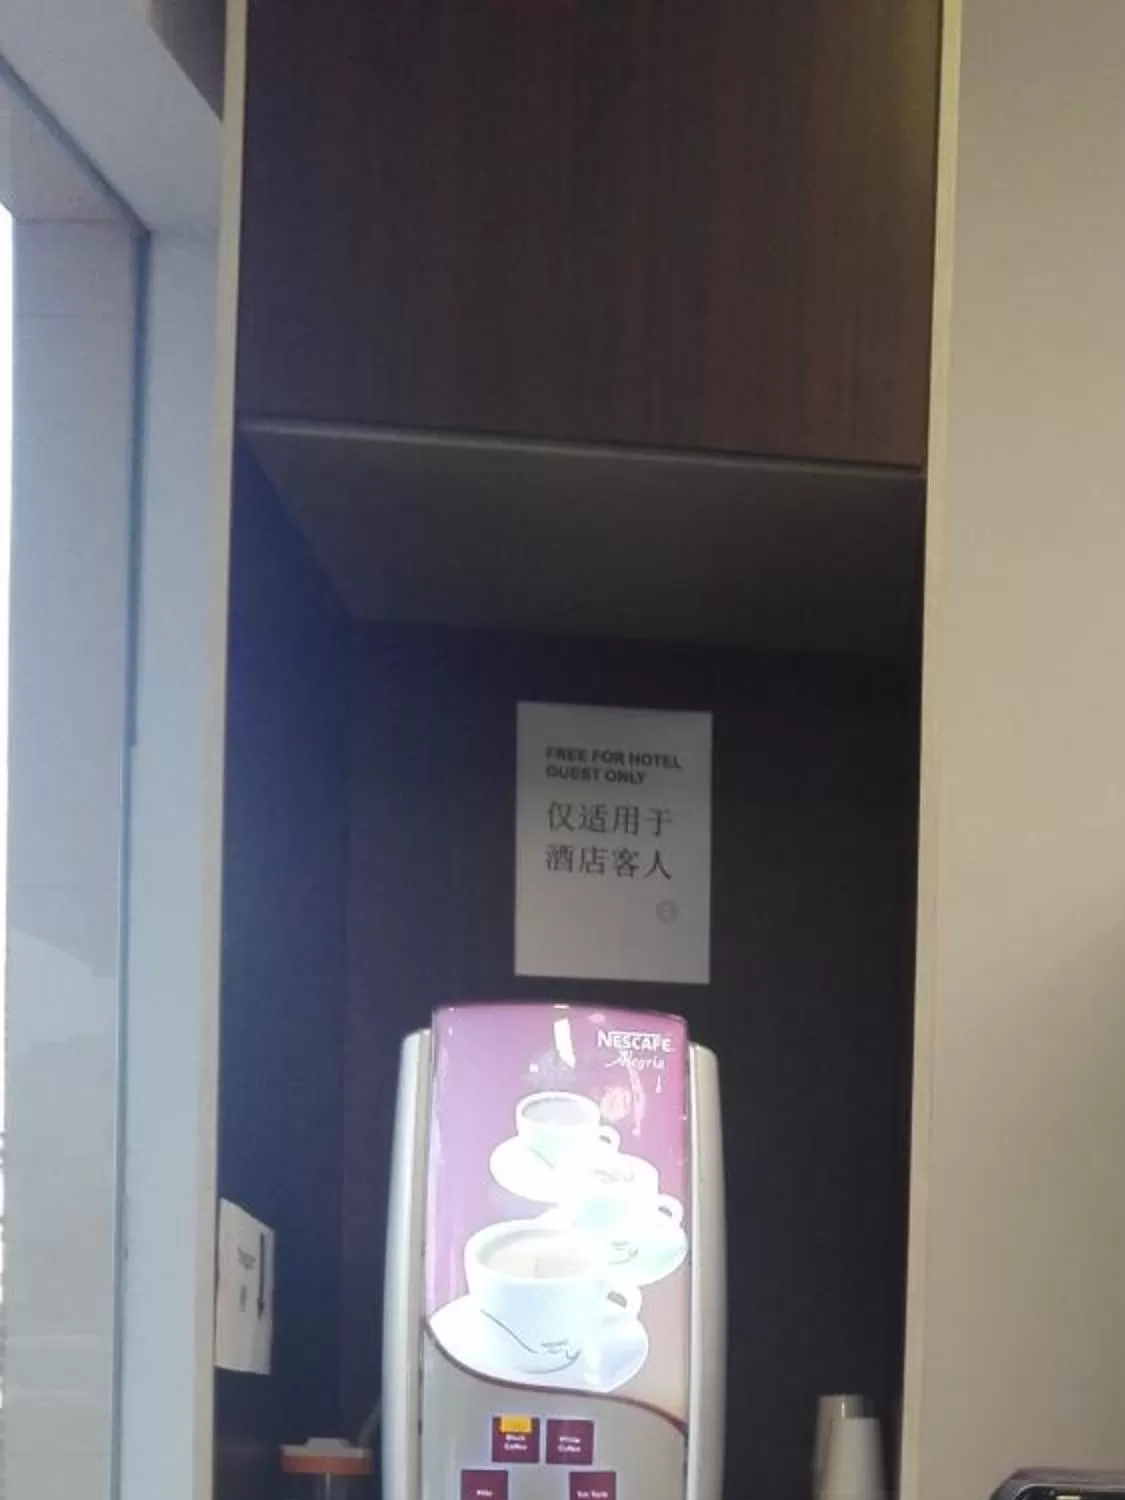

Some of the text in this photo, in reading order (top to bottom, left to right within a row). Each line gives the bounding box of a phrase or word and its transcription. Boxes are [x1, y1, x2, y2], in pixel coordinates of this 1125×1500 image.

[546, 745, 683, 769] FREE FOR HOTEL
[604, 767, 647, 785] ONLY
[546, 800, 673, 838] 仅适用于
[545, 842, 673, 881] 酒店客人
